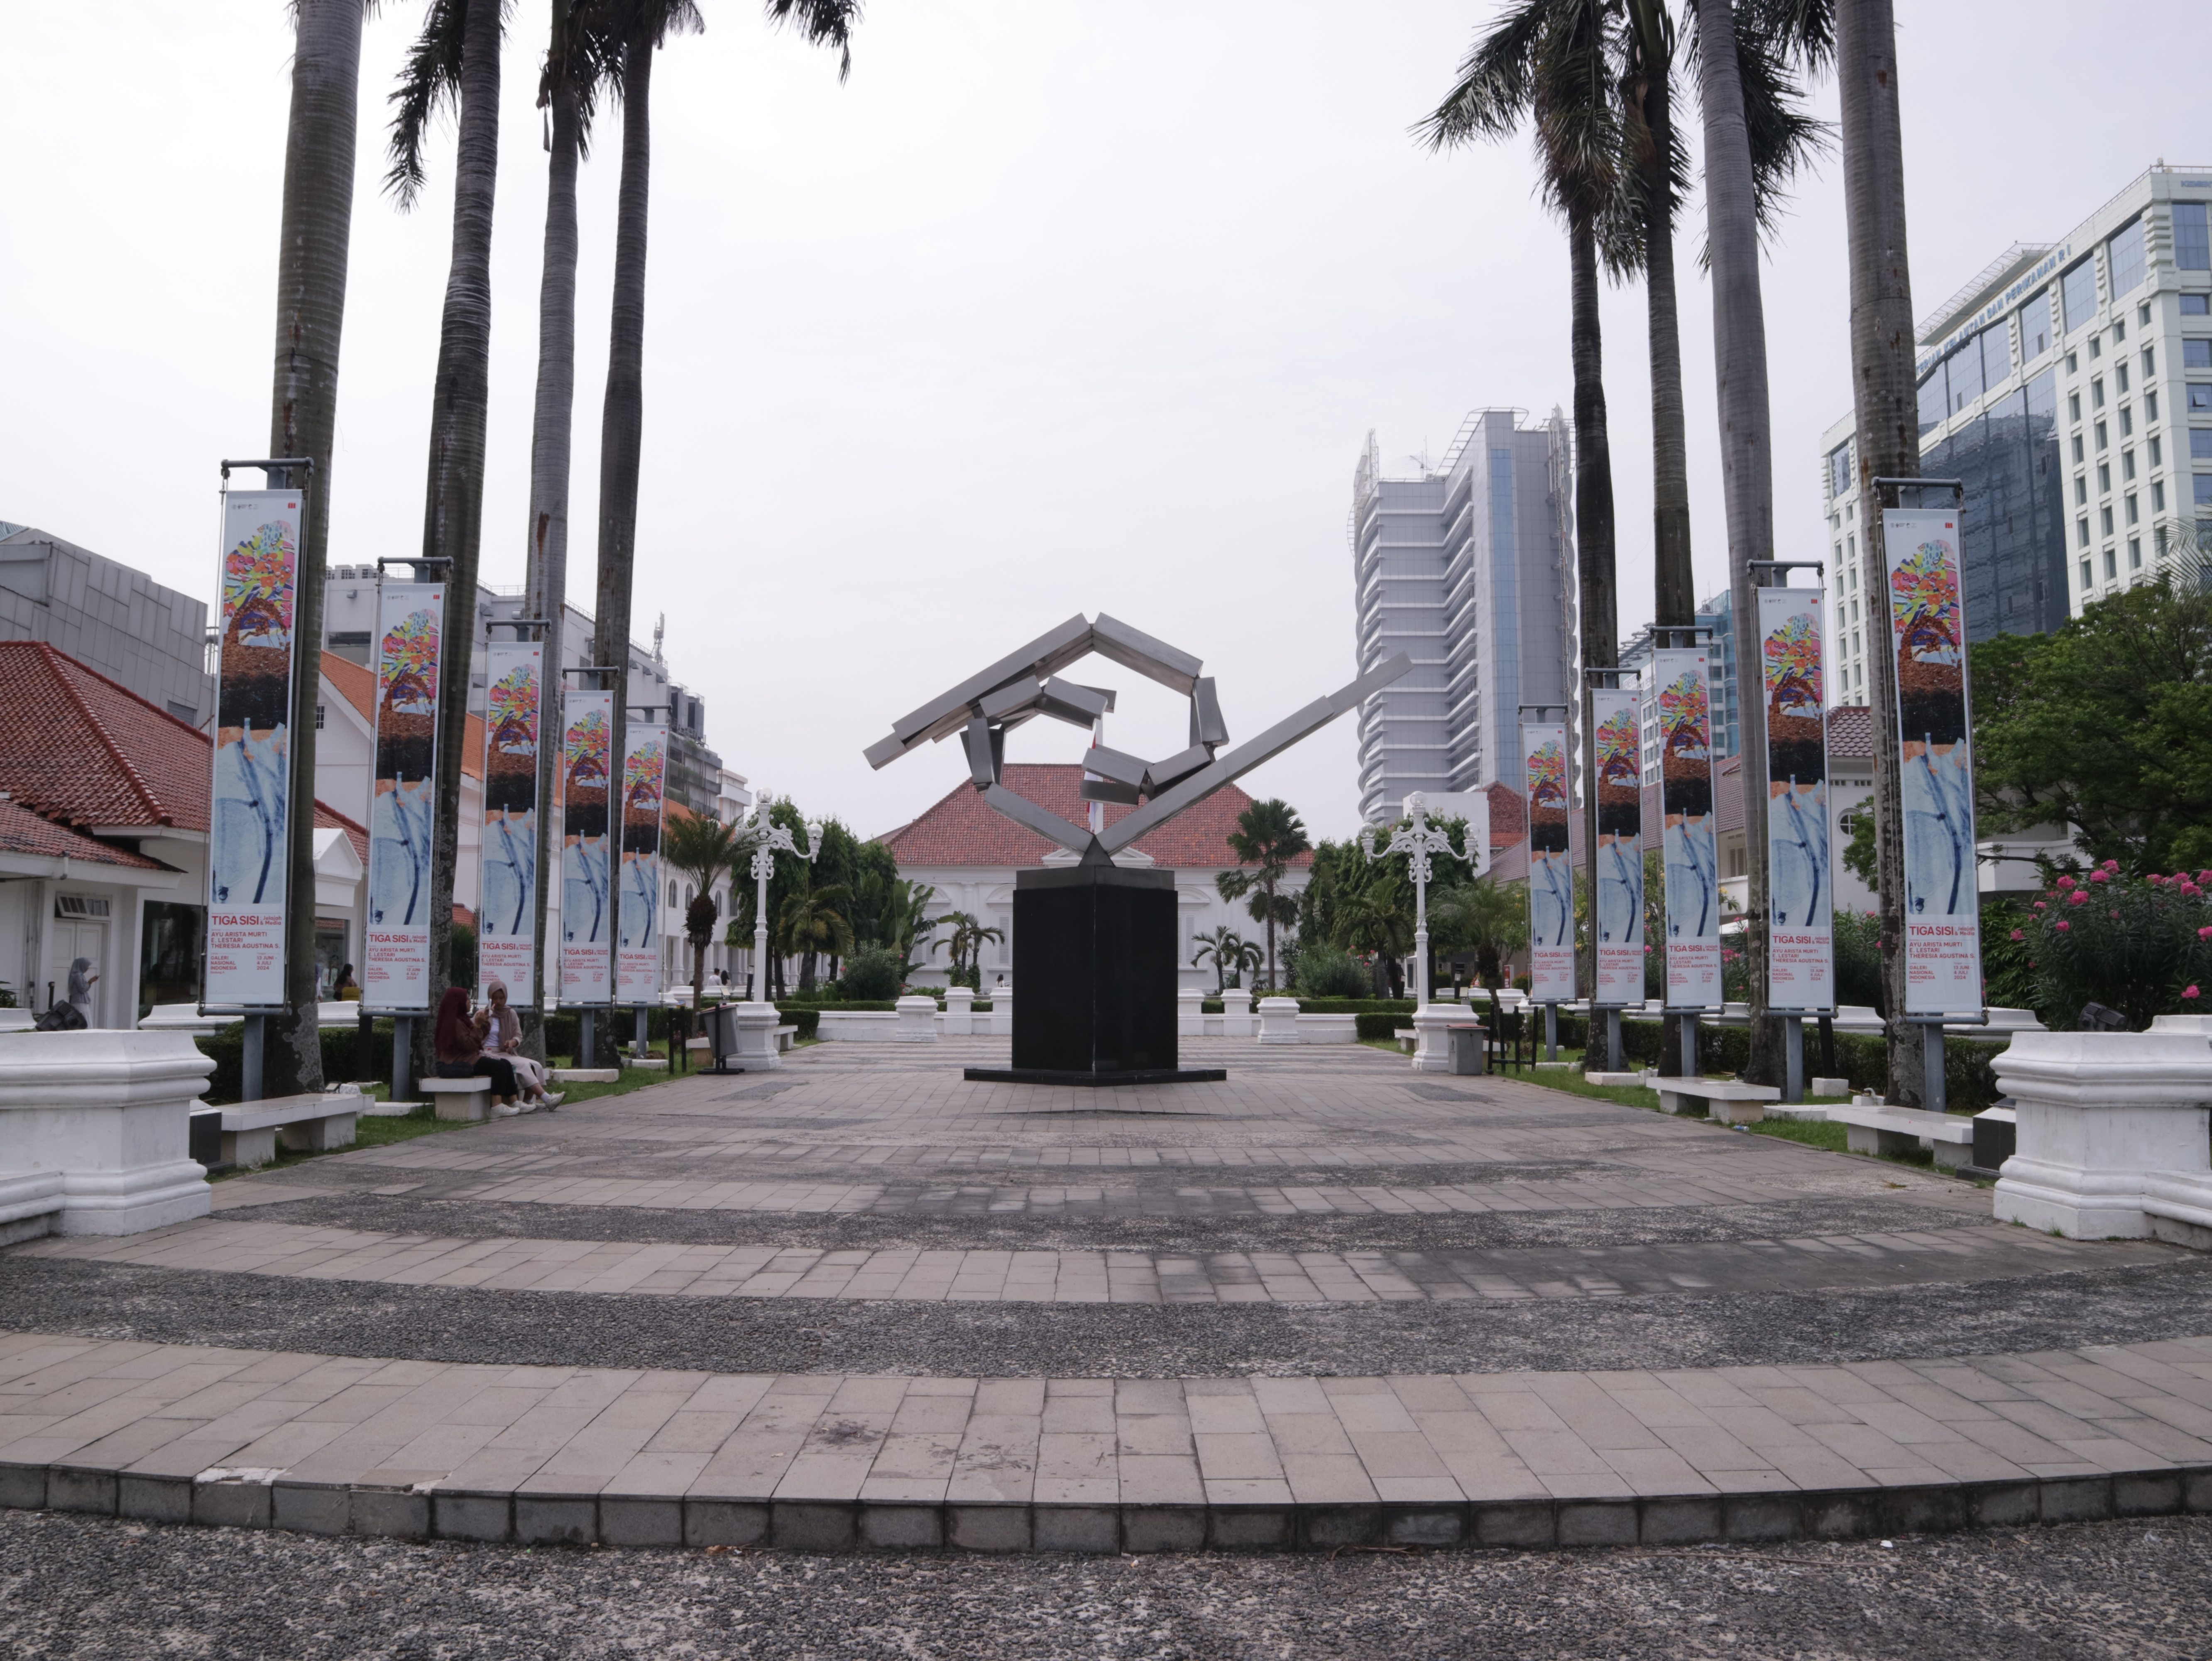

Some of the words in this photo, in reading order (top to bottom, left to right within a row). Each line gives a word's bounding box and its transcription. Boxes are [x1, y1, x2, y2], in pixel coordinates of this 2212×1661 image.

[1916, 348, 1941, 375] TERIAN
[1943, 313, 1985, 353] KELAUTAN
[1987, 298, 2004, 319] DAN
[2005, 255, 2056, 304] PERIKANAN
[2058, 249, 2065, 262] R
[2066, 243, 2071, 256] I
[212, 916, 237, 925] TIGA
[240, 916, 259, 925] SISI
[1909, 926, 1934, 935] TIGA
[1936, 926, 1954, 935] SISI
